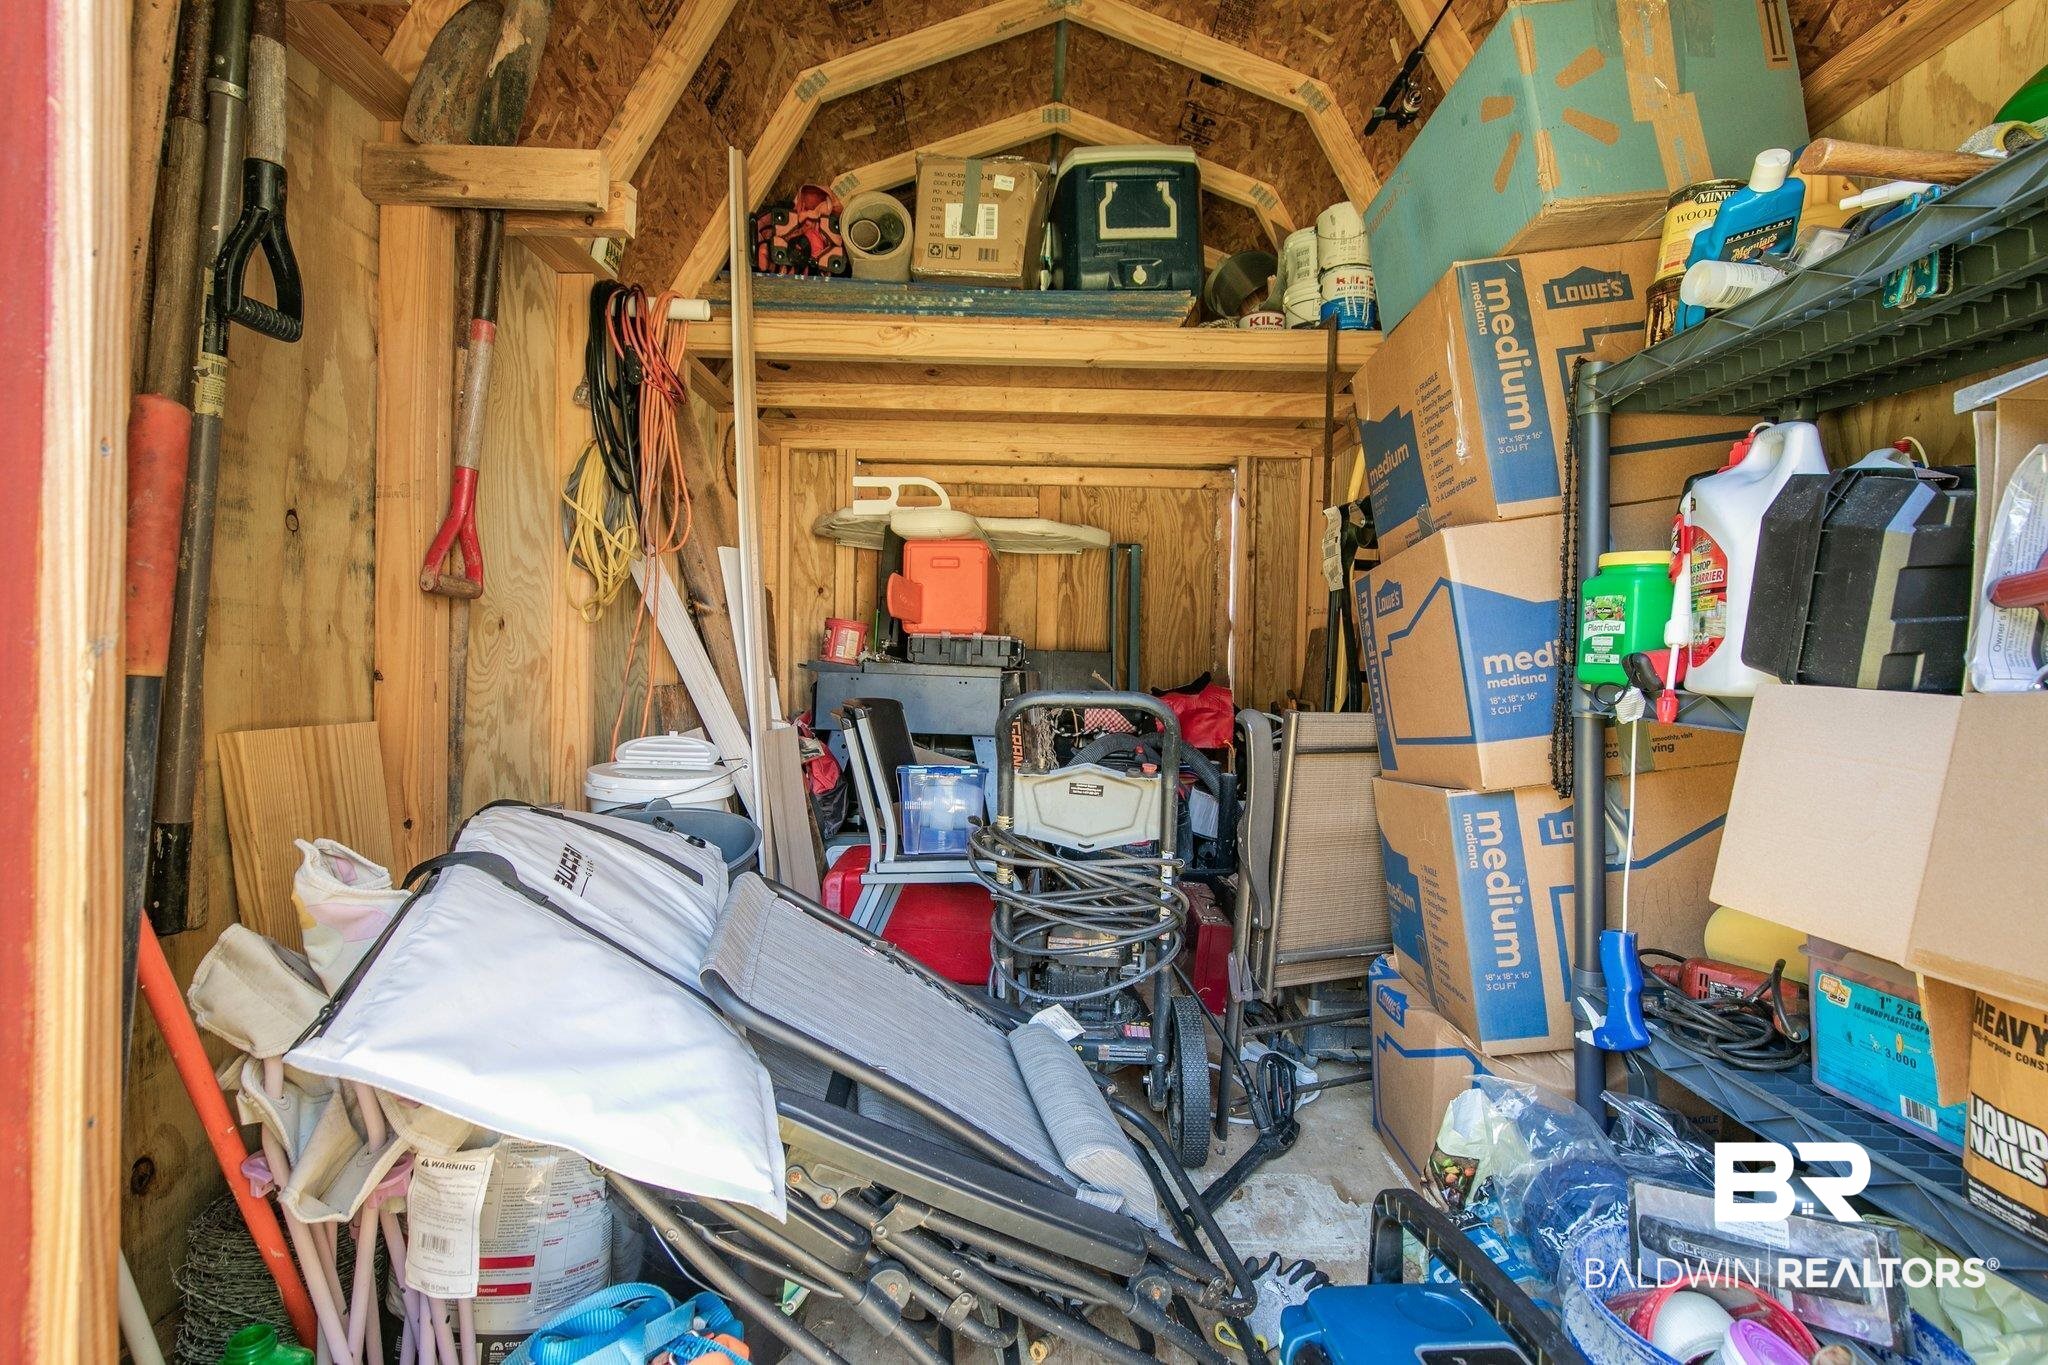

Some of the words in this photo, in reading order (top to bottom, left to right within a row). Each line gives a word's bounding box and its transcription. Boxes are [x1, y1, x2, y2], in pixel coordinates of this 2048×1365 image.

[1698, 191, 1733, 204] MINW
[1470, 281, 1488, 336] mediana
[1552, 278, 1624, 304] LOWE'S
[1250, 316, 1283, 328] KILZ
[1483, 277, 1533, 431] medium
[1369, 443, 1411, 487] medium
[1377, 590, 1401, 613] LOWE'S
[1603, 623, 1621, 632] Food
[1360, 591, 1384, 717] medium
[1483, 637, 1561, 676] medi
[1487, 674, 1547, 689] mediana
[1462, 813, 1478, 870] mediana
[1476, 811, 1522, 969] medium
[1973, 997, 2048, 1057] HEAVY
[1970, 1094, 2048, 1160] LIQUID
[429, 1160, 476, 1172] WARNING
[1970, 1120, 2048, 1188] NAILS
